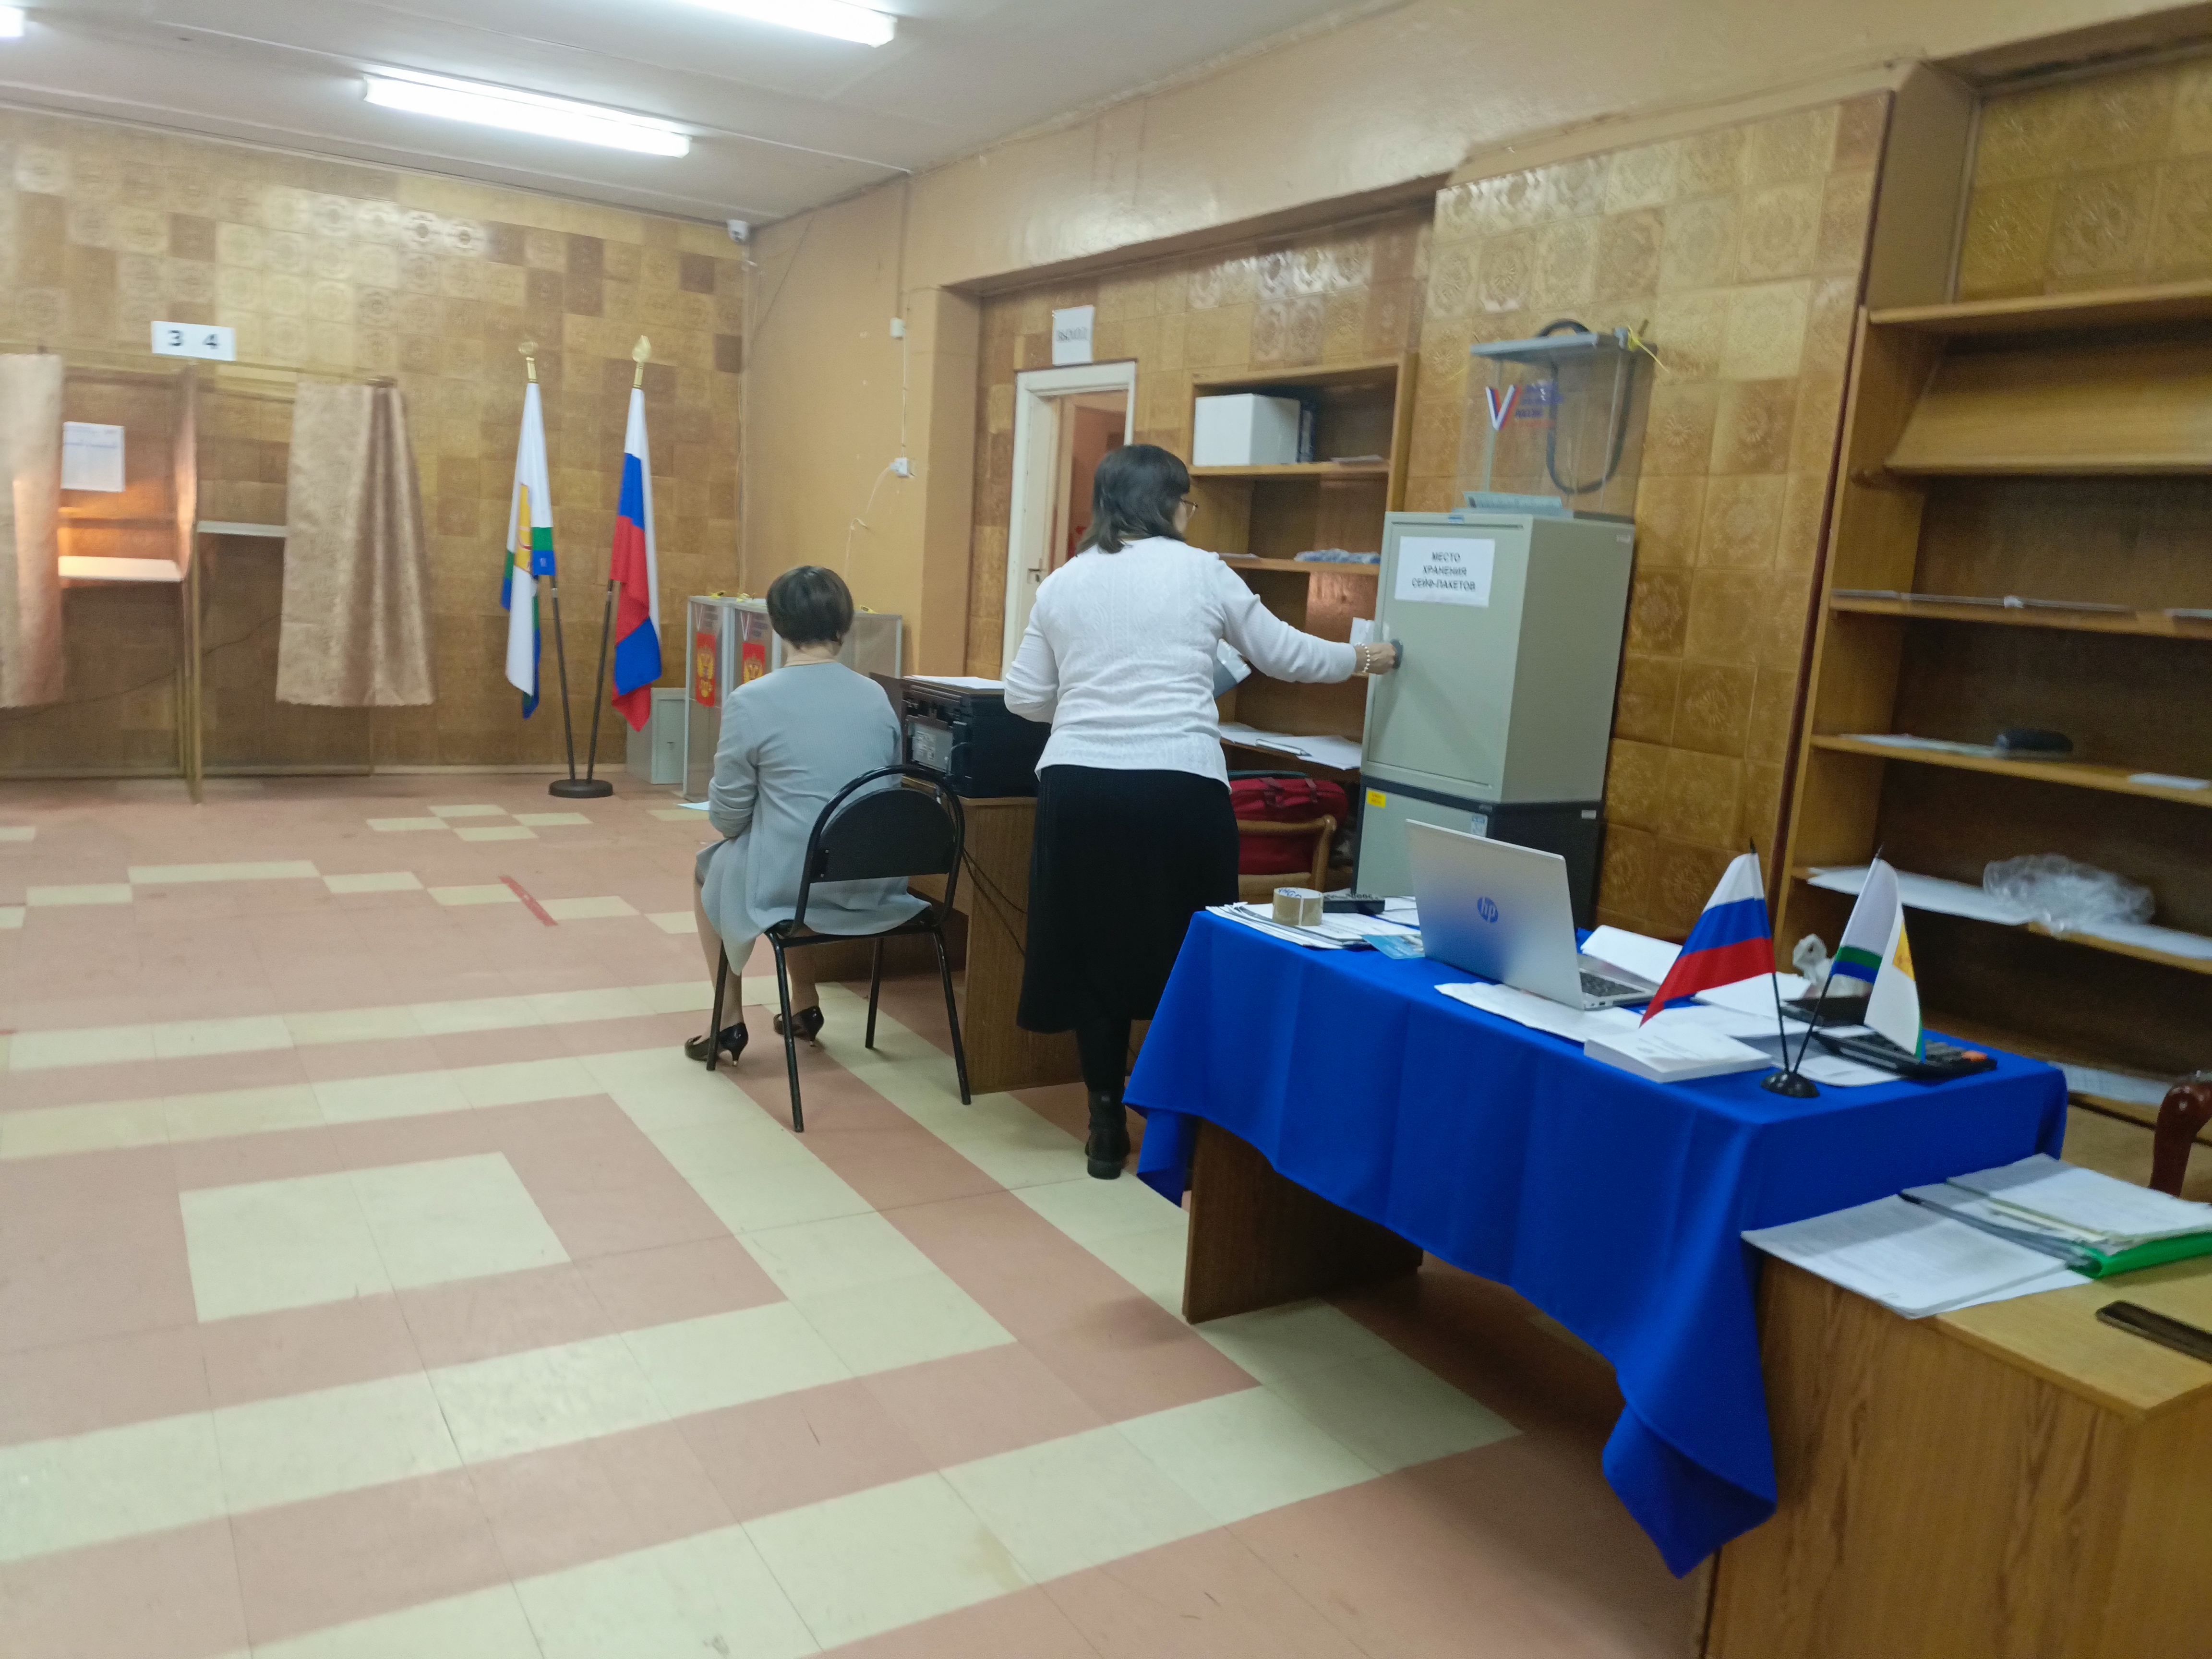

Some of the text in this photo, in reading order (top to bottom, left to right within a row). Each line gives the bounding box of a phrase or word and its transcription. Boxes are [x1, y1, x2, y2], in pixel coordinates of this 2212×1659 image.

[168, 330, 219, 349] 3 4
[1431, 552, 1461, 563] МЕСТО
[1423, 565, 1467, 576] ХРАНЕНИЯ
[1412, 577, 1476, 591] СЕЙФ-ПАКЕТОВ
[1481, 897, 1496, 923] hp
